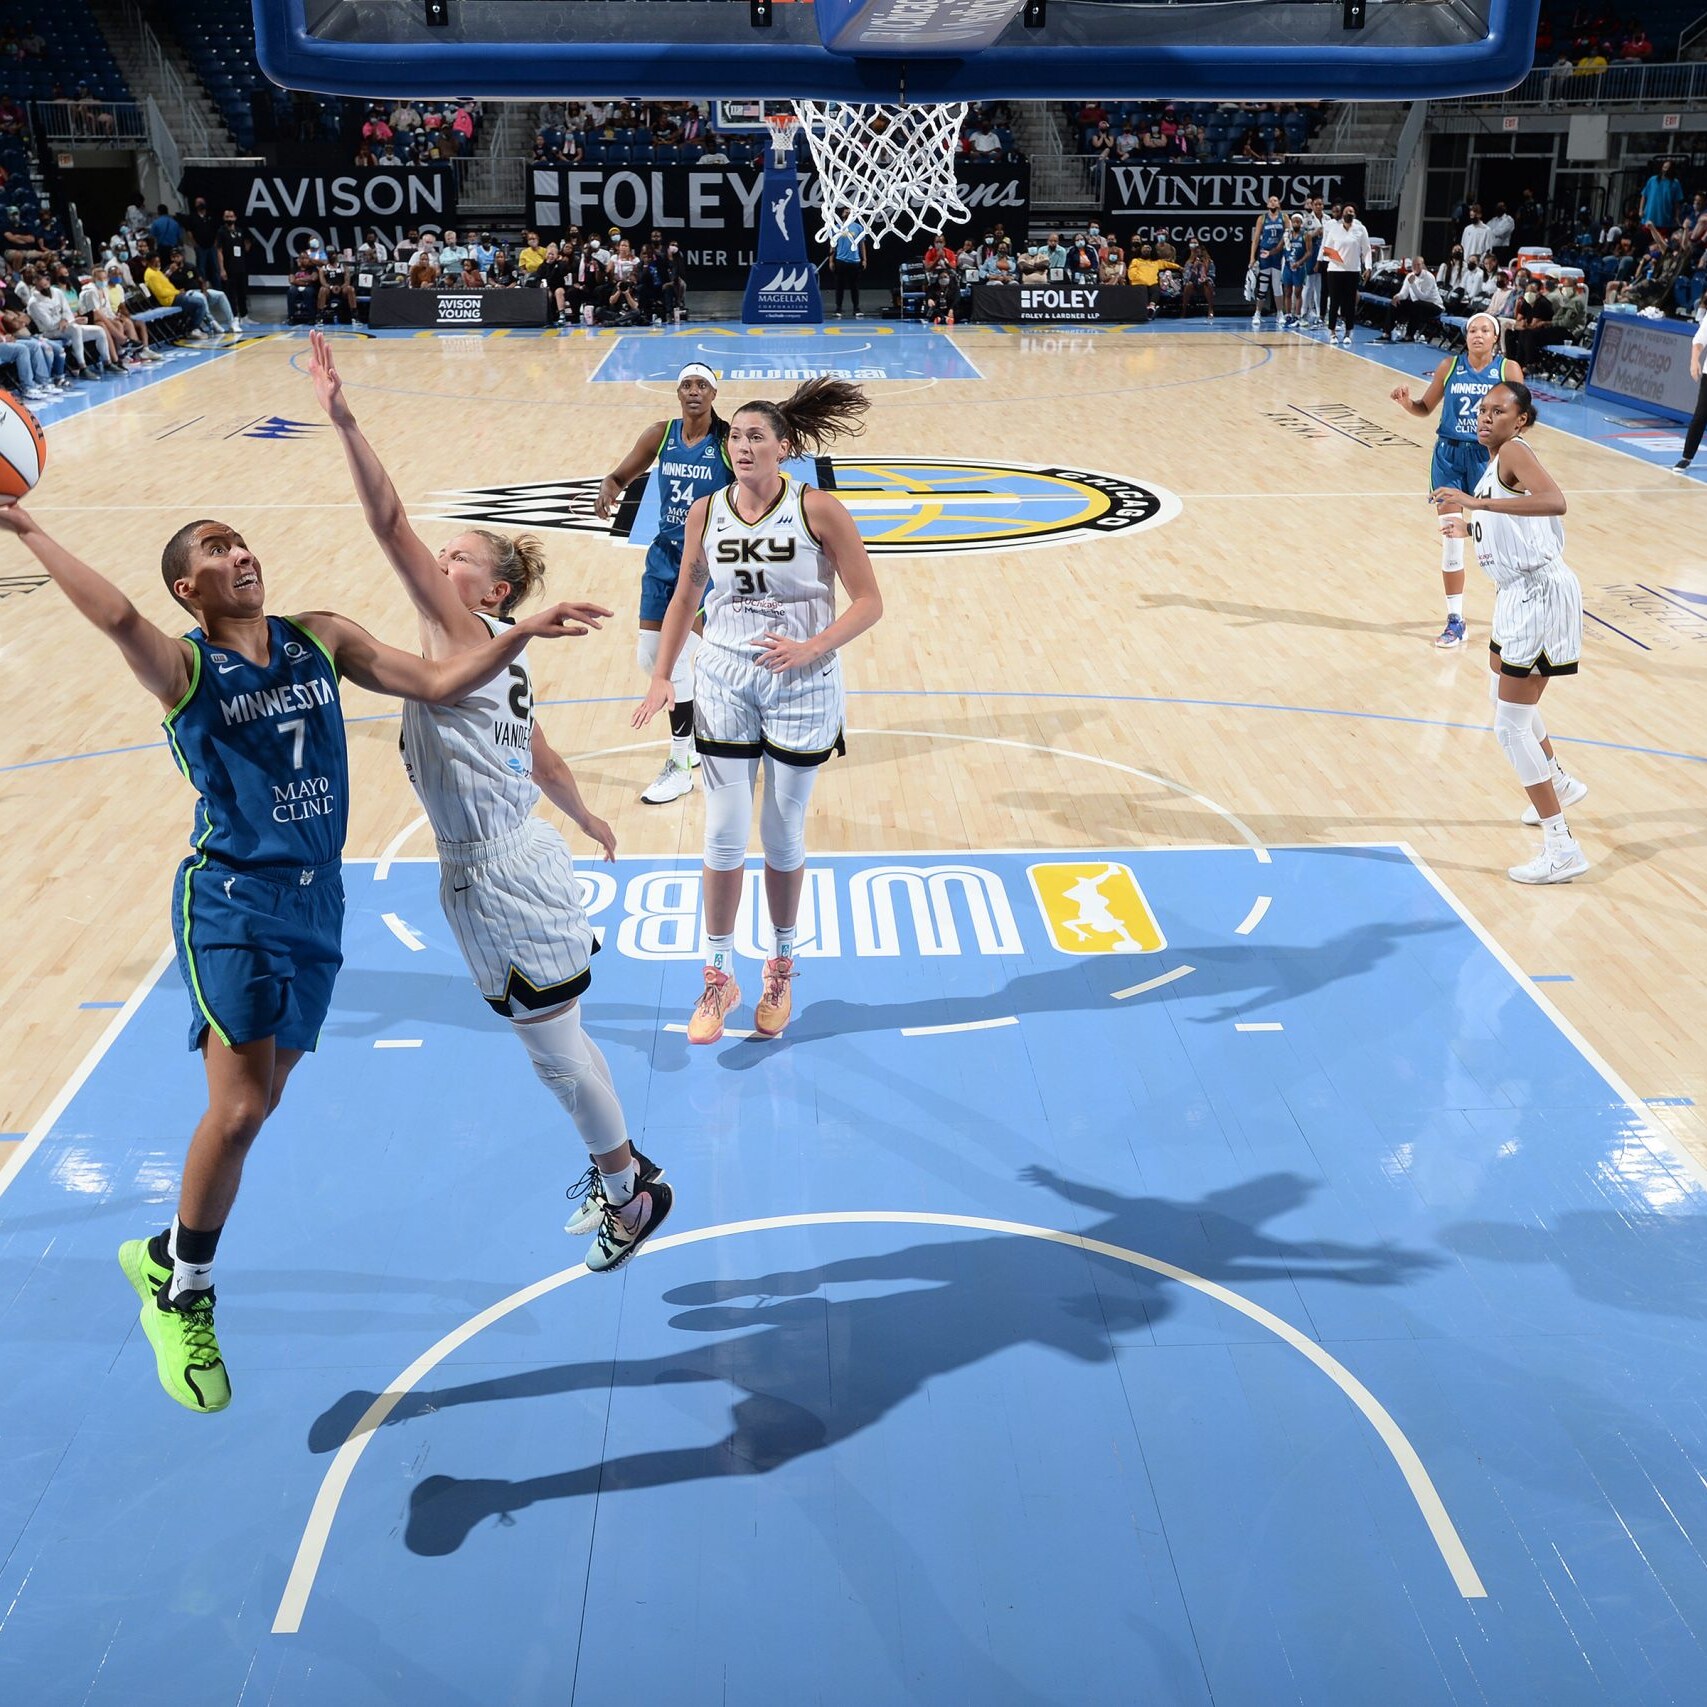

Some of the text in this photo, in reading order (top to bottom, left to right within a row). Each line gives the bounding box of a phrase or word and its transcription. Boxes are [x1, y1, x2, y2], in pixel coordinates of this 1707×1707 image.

[245, 173, 443, 217] AVISON
[568, 170, 764, 228] FOLEY
[1110, 166, 1342, 206] WINTRUST
[1137, 226, 1245, 242] CHCAGO'S
[438, 299, 481, 309] AVISON
[758, 294, 809, 303] MAGELLAN
[1031, 290, 1099, 308] FOLEY
[438, 308, 481, 318] YOUNG
[1621, 341, 1672, 374] UChicago
[1450, 382, 1494, 395] MINNESOT
[1613, 366, 1665, 399] Medicine
[1459, 396, 1482, 416] 24
[1454, 425, 1478, 433] CLIN
[1457, 418, 1478, 427] MAY
[661, 461, 713, 480] MINNESOTA
[670, 479, 695, 506] 34
[1055, 471, 1149, 526] CHICAGO
[713, 536, 797, 564] SKY
[734, 567, 768, 595] 31
[220, 677, 335, 726] MINNESOTA
[276, 718, 306, 771] 7
[494, 720, 532, 753] VANDE
[272, 776, 330, 803] MAYO
